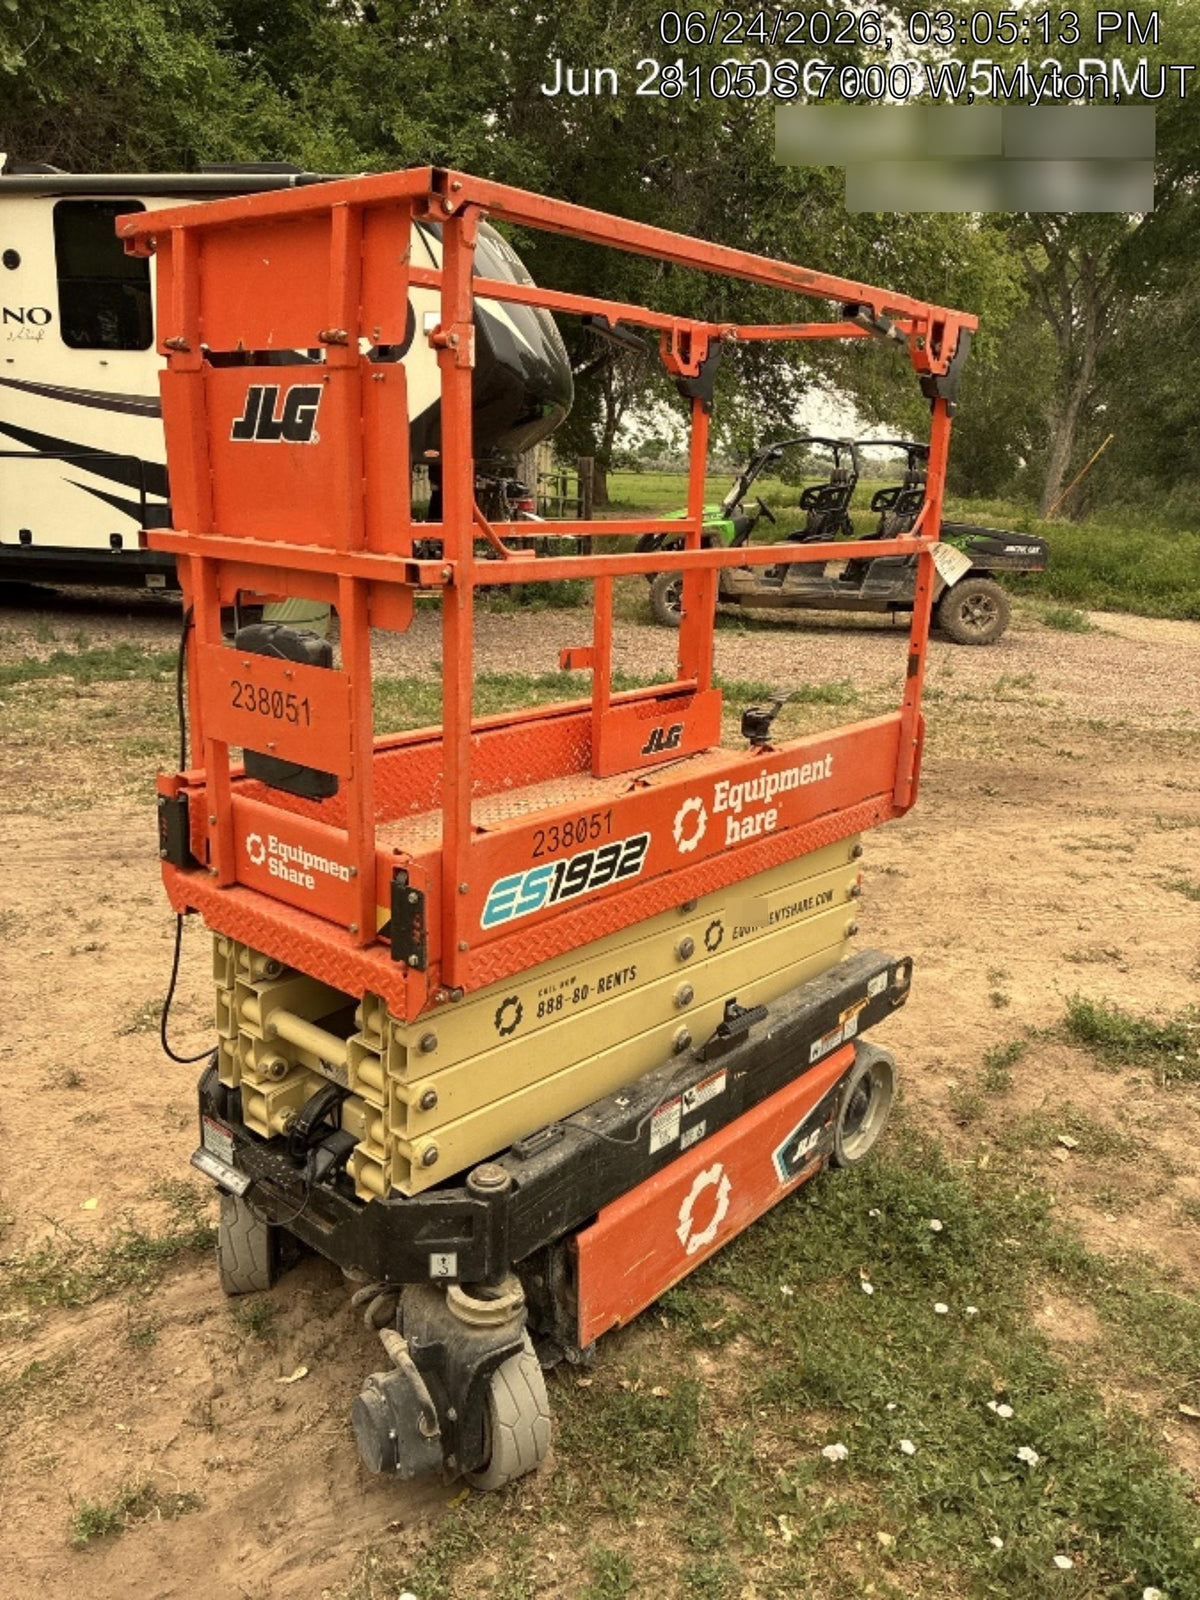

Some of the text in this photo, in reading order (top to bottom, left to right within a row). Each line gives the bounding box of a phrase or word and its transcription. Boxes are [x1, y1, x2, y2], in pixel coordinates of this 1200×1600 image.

[230, 383, 324, 444] JLG
[230, 680, 311, 727] 238051
[641, 723, 684, 756] JLG
[712, 752, 834, 815] Equipment
[531, 808, 614, 859] 238051
[267, 857, 316, 890] Share
[480, 831, 652, 931] ES1932
[536, 964, 638, 1018] 888-80-RENTS
